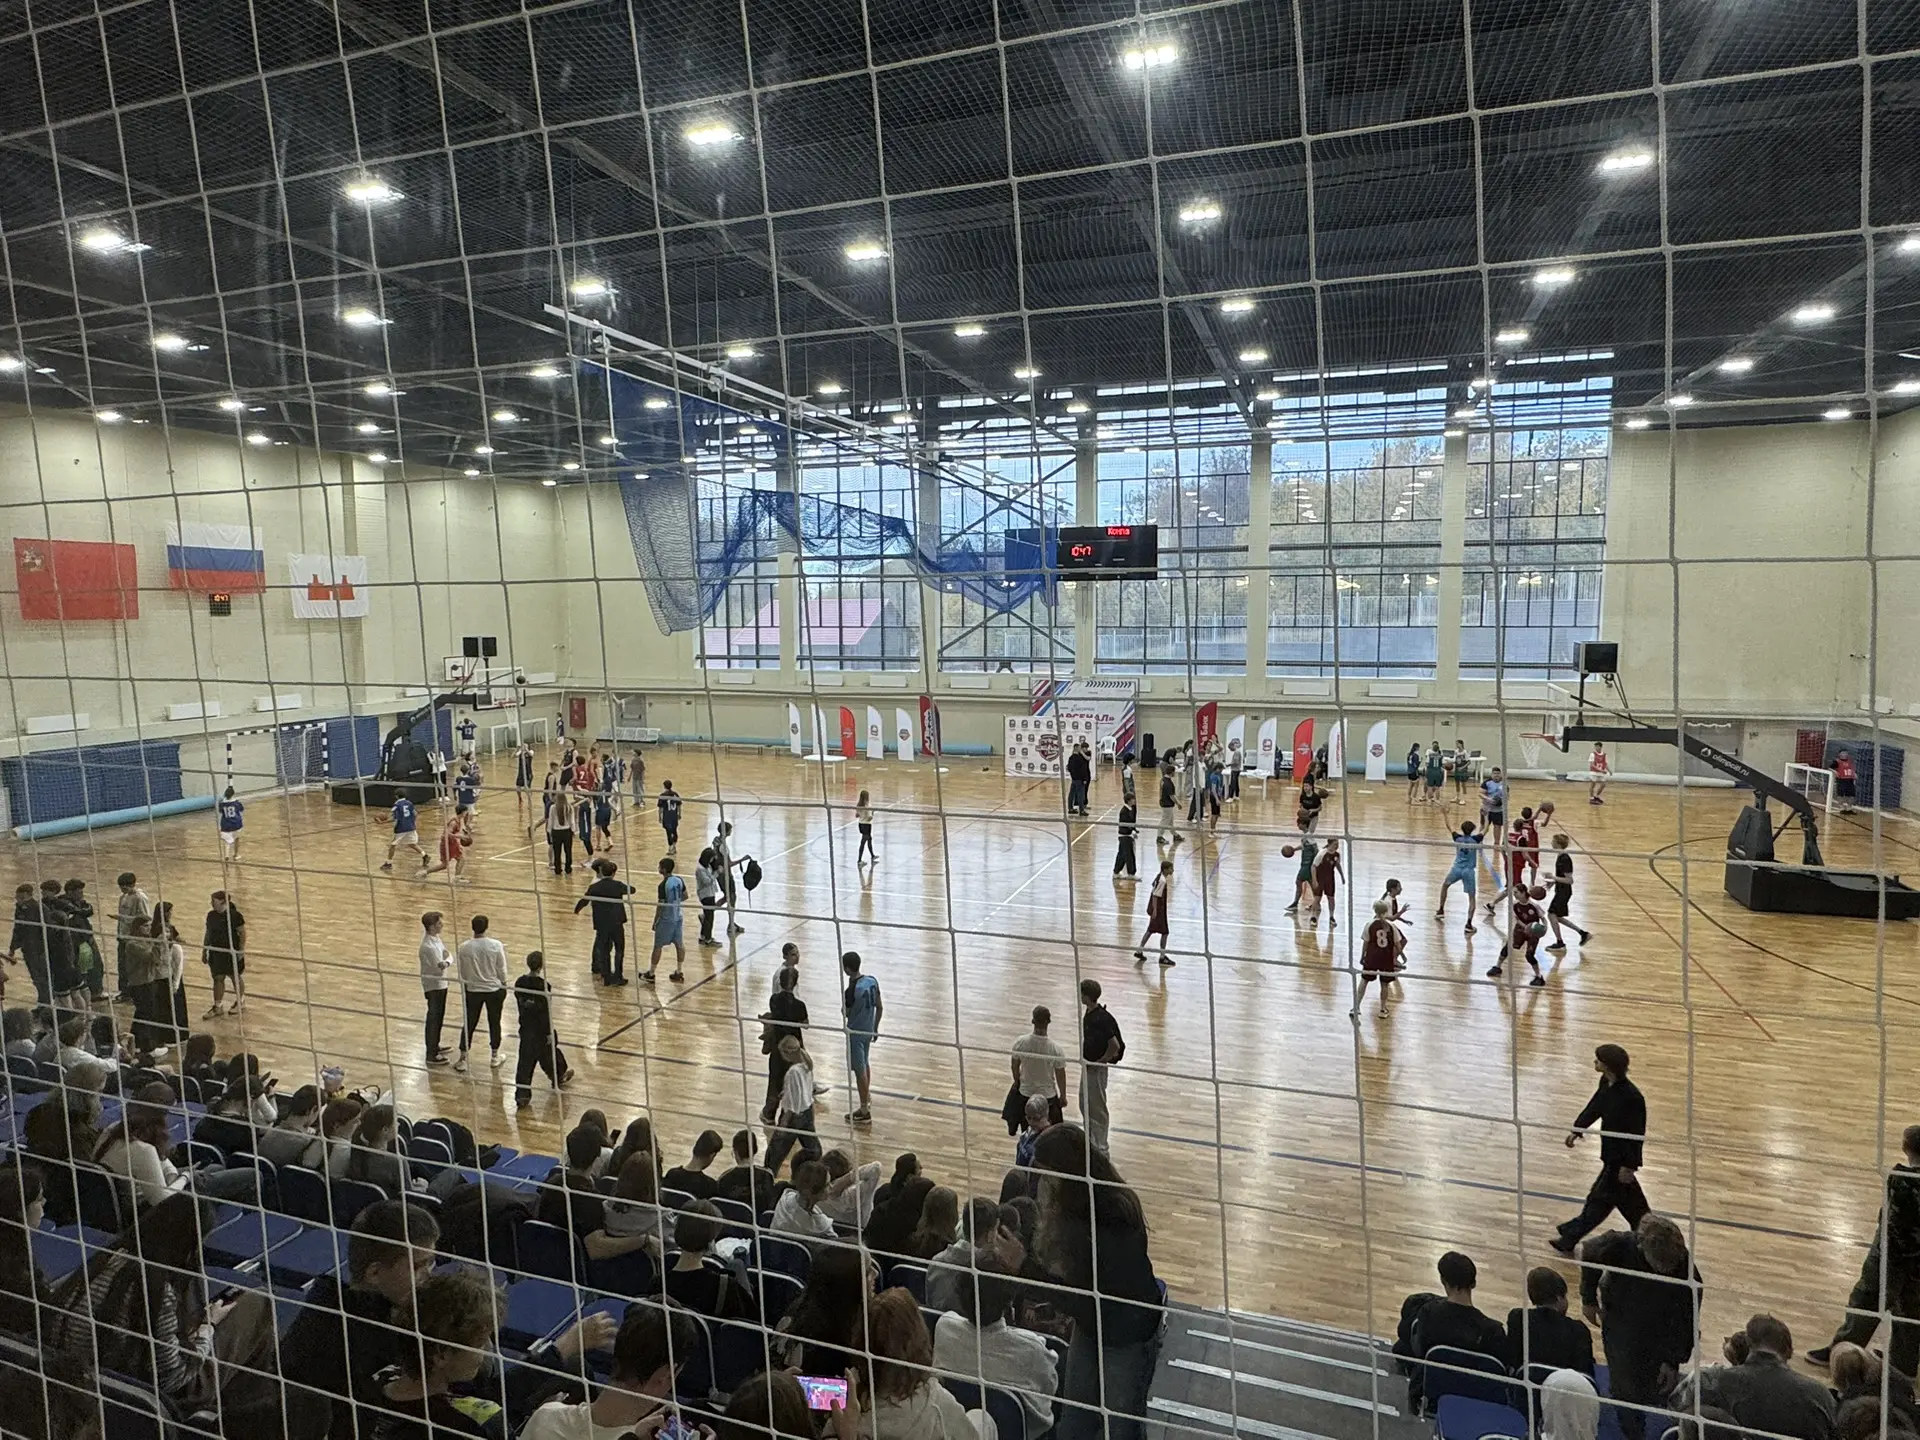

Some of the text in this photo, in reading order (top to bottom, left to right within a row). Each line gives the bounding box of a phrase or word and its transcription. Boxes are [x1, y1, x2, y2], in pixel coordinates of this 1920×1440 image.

[223, 805, 236, 818] 18
[403, 805, 411, 817] 5
[1376, 928, 1389, 948] 8
